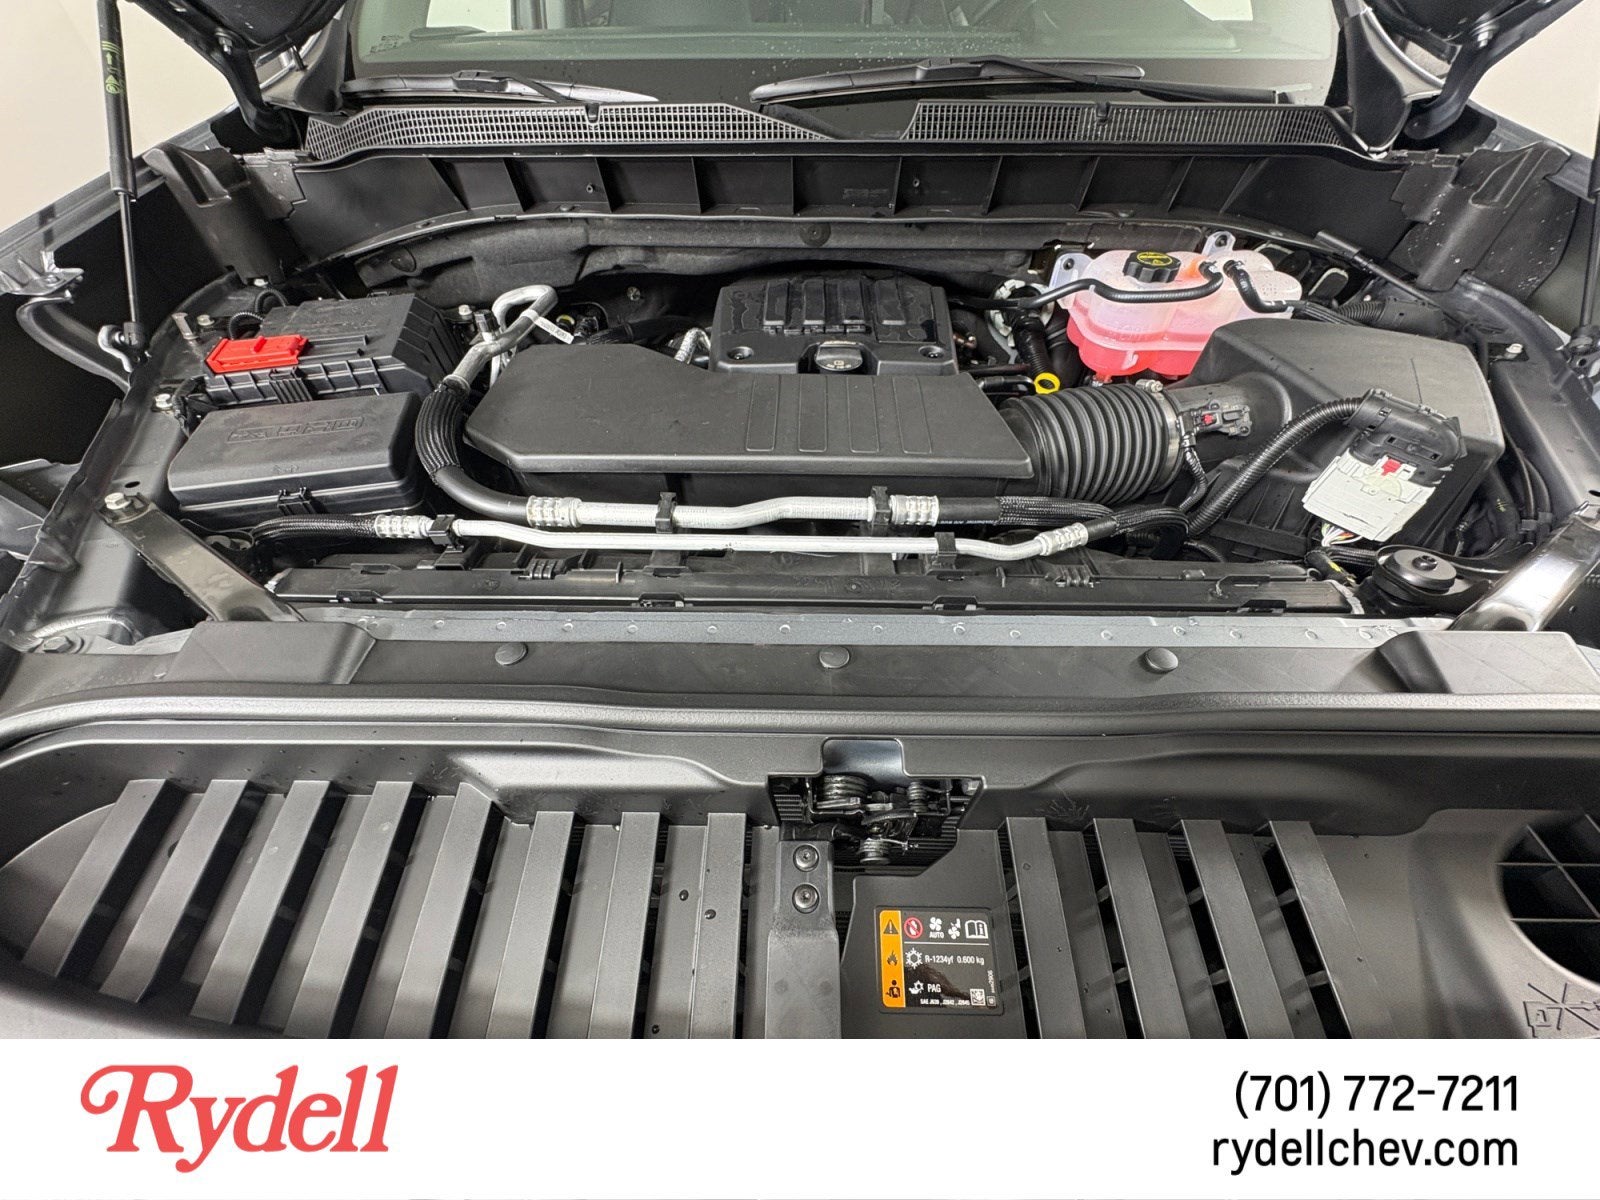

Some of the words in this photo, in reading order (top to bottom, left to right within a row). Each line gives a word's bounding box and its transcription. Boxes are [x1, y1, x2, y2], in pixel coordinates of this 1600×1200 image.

[929, 931, 945, 939] AUTO
[924, 954, 954, 966] R-1234yf
[956, 955, 976, 964] 0.600
[976, 956, 985, 966] kg
[927, 983, 942, 993] PAG
